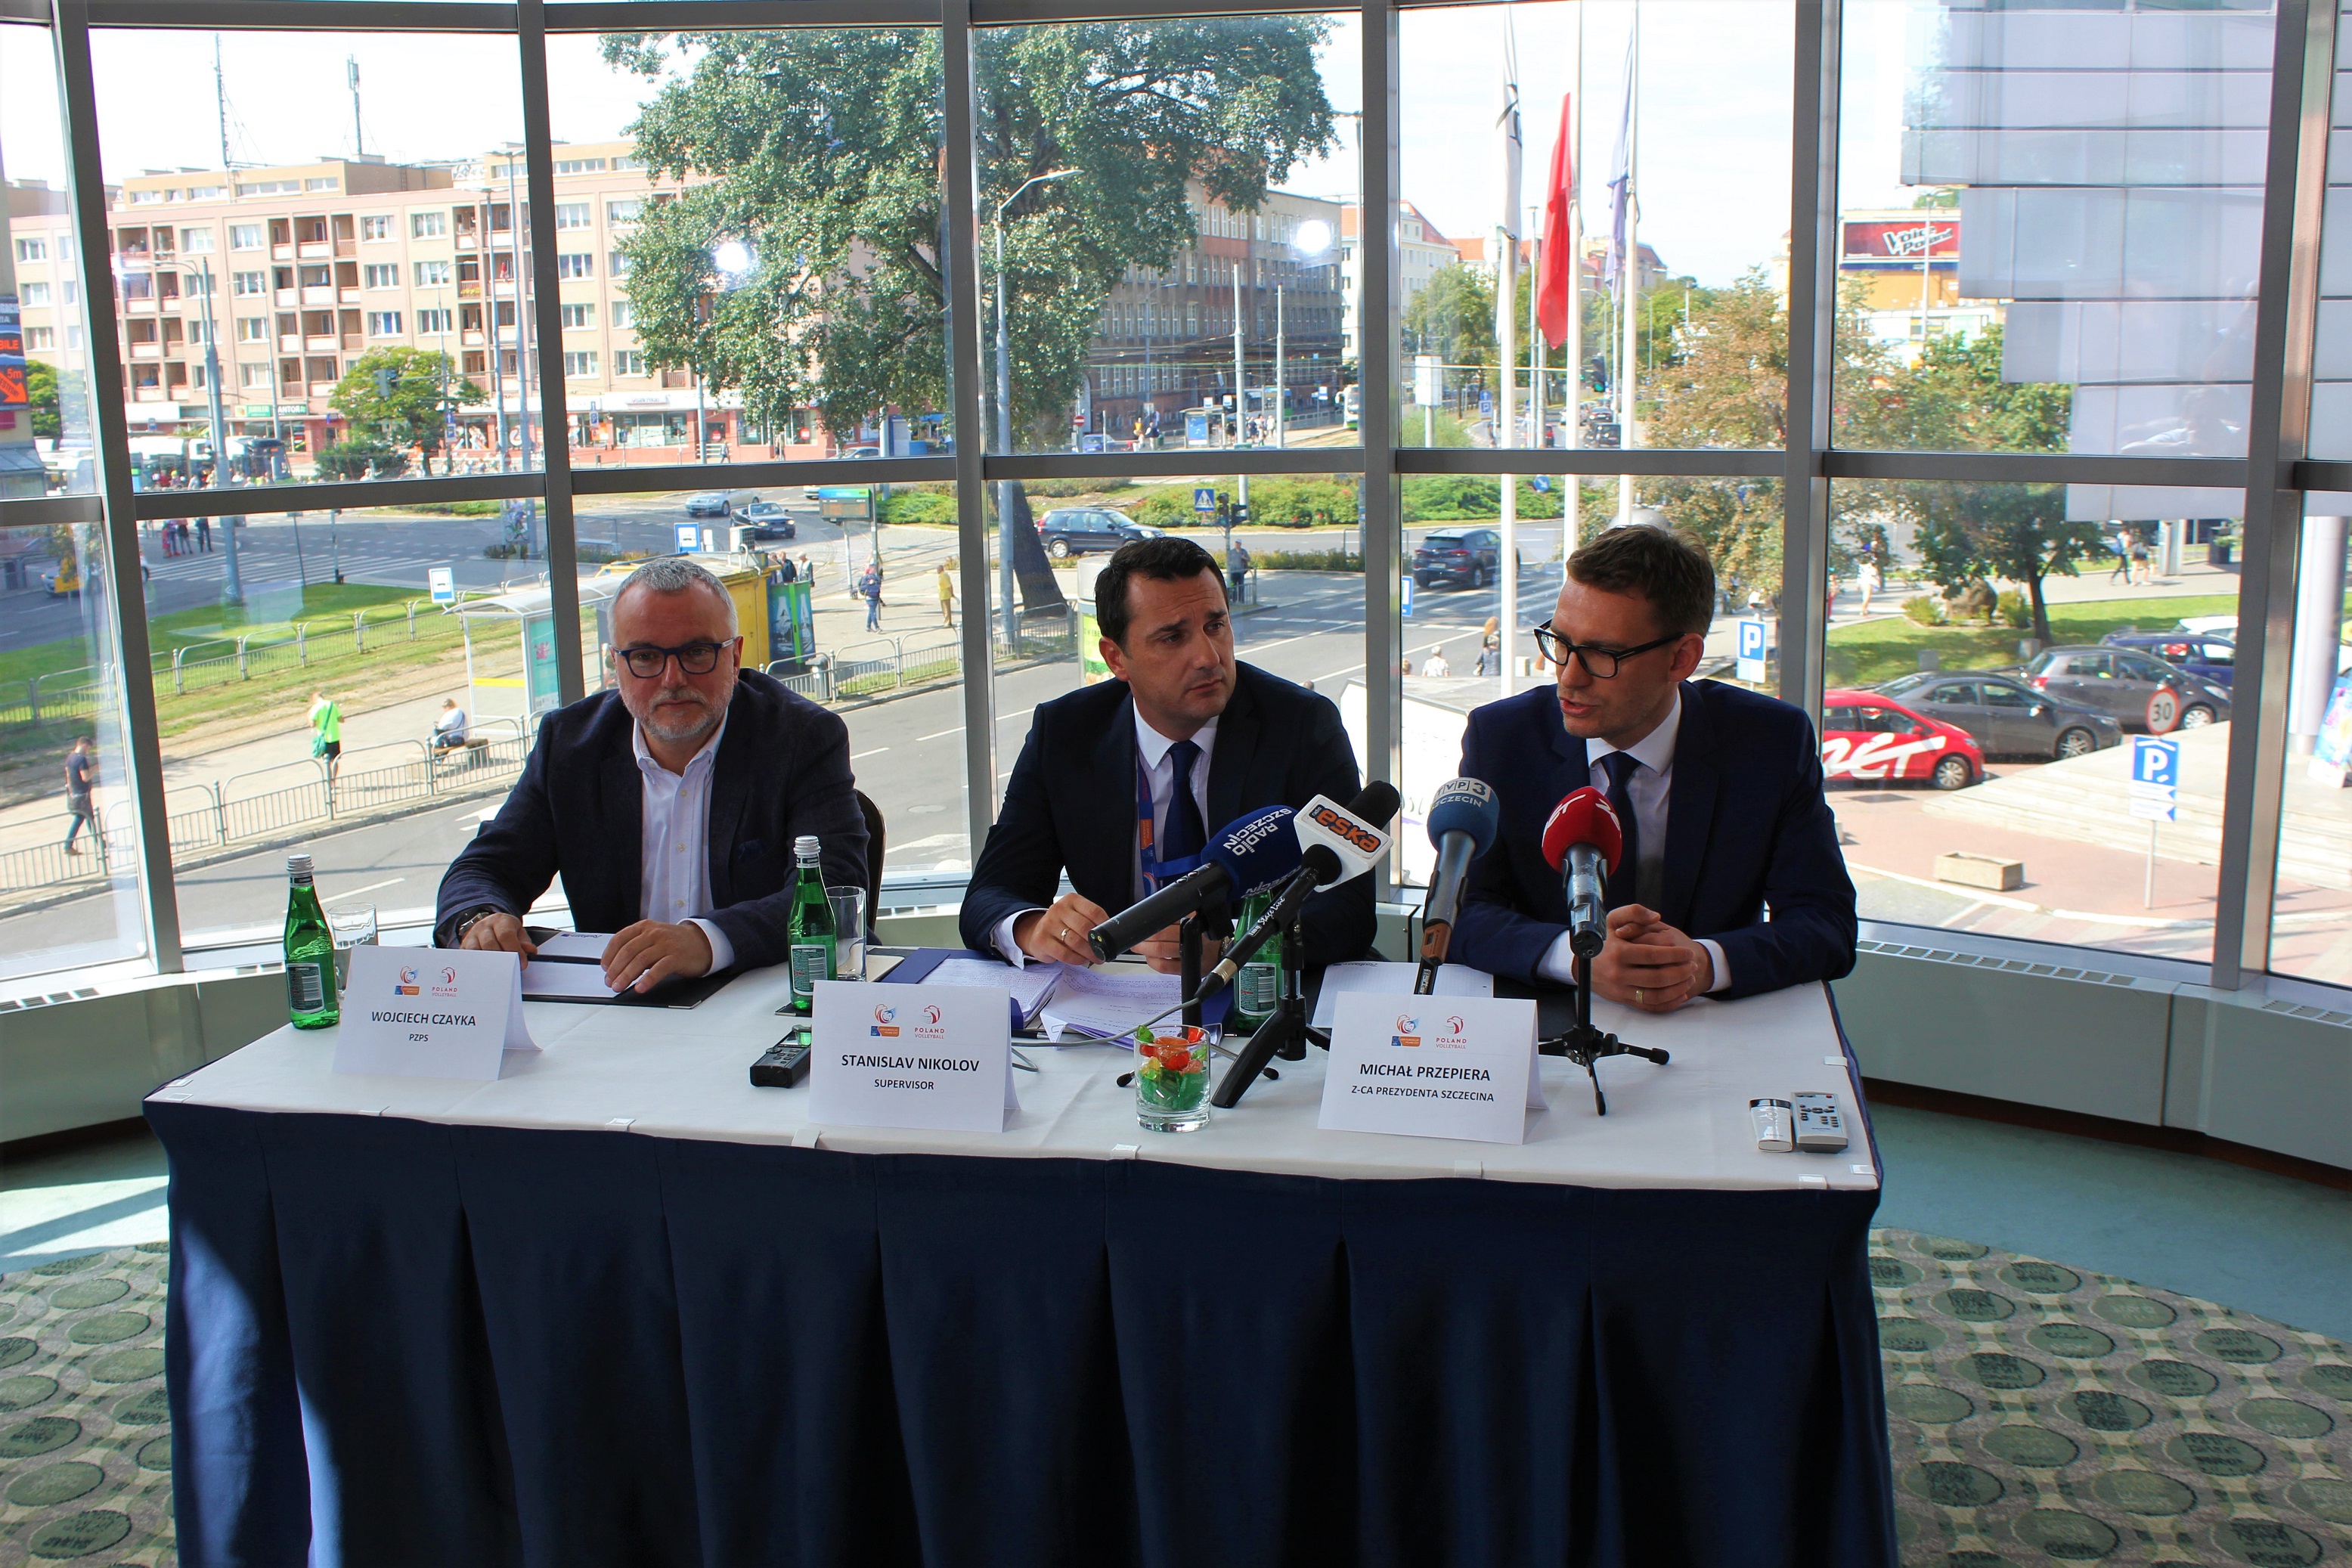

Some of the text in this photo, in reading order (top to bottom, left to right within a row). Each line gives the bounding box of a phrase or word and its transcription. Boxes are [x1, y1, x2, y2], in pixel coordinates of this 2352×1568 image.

[277, 405, 300, 414] ANTOR
[1743, 624, 1762, 656] P
[2152, 702, 2172, 721] 30
[2143, 748, 2168, 781] P
[1222, 807, 1293, 850] SZCZECIN
[1316, 808, 1381, 853] eska
[371, 1011, 476, 1027] WOJCIECH CZAYKA
[409, 1033, 429, 1043] PZPS
[841, 1054, 981, 1072] STANISLAV NIKOLOV
[1359, 1063, 1491, 1081] MICHAŁ PRZEPIERA
[874, 1079, 935, 1090] SUPERVISOR
[1351, 1085, 1495, 1102] Z-CA PREZYDENTA SZCZECINA
